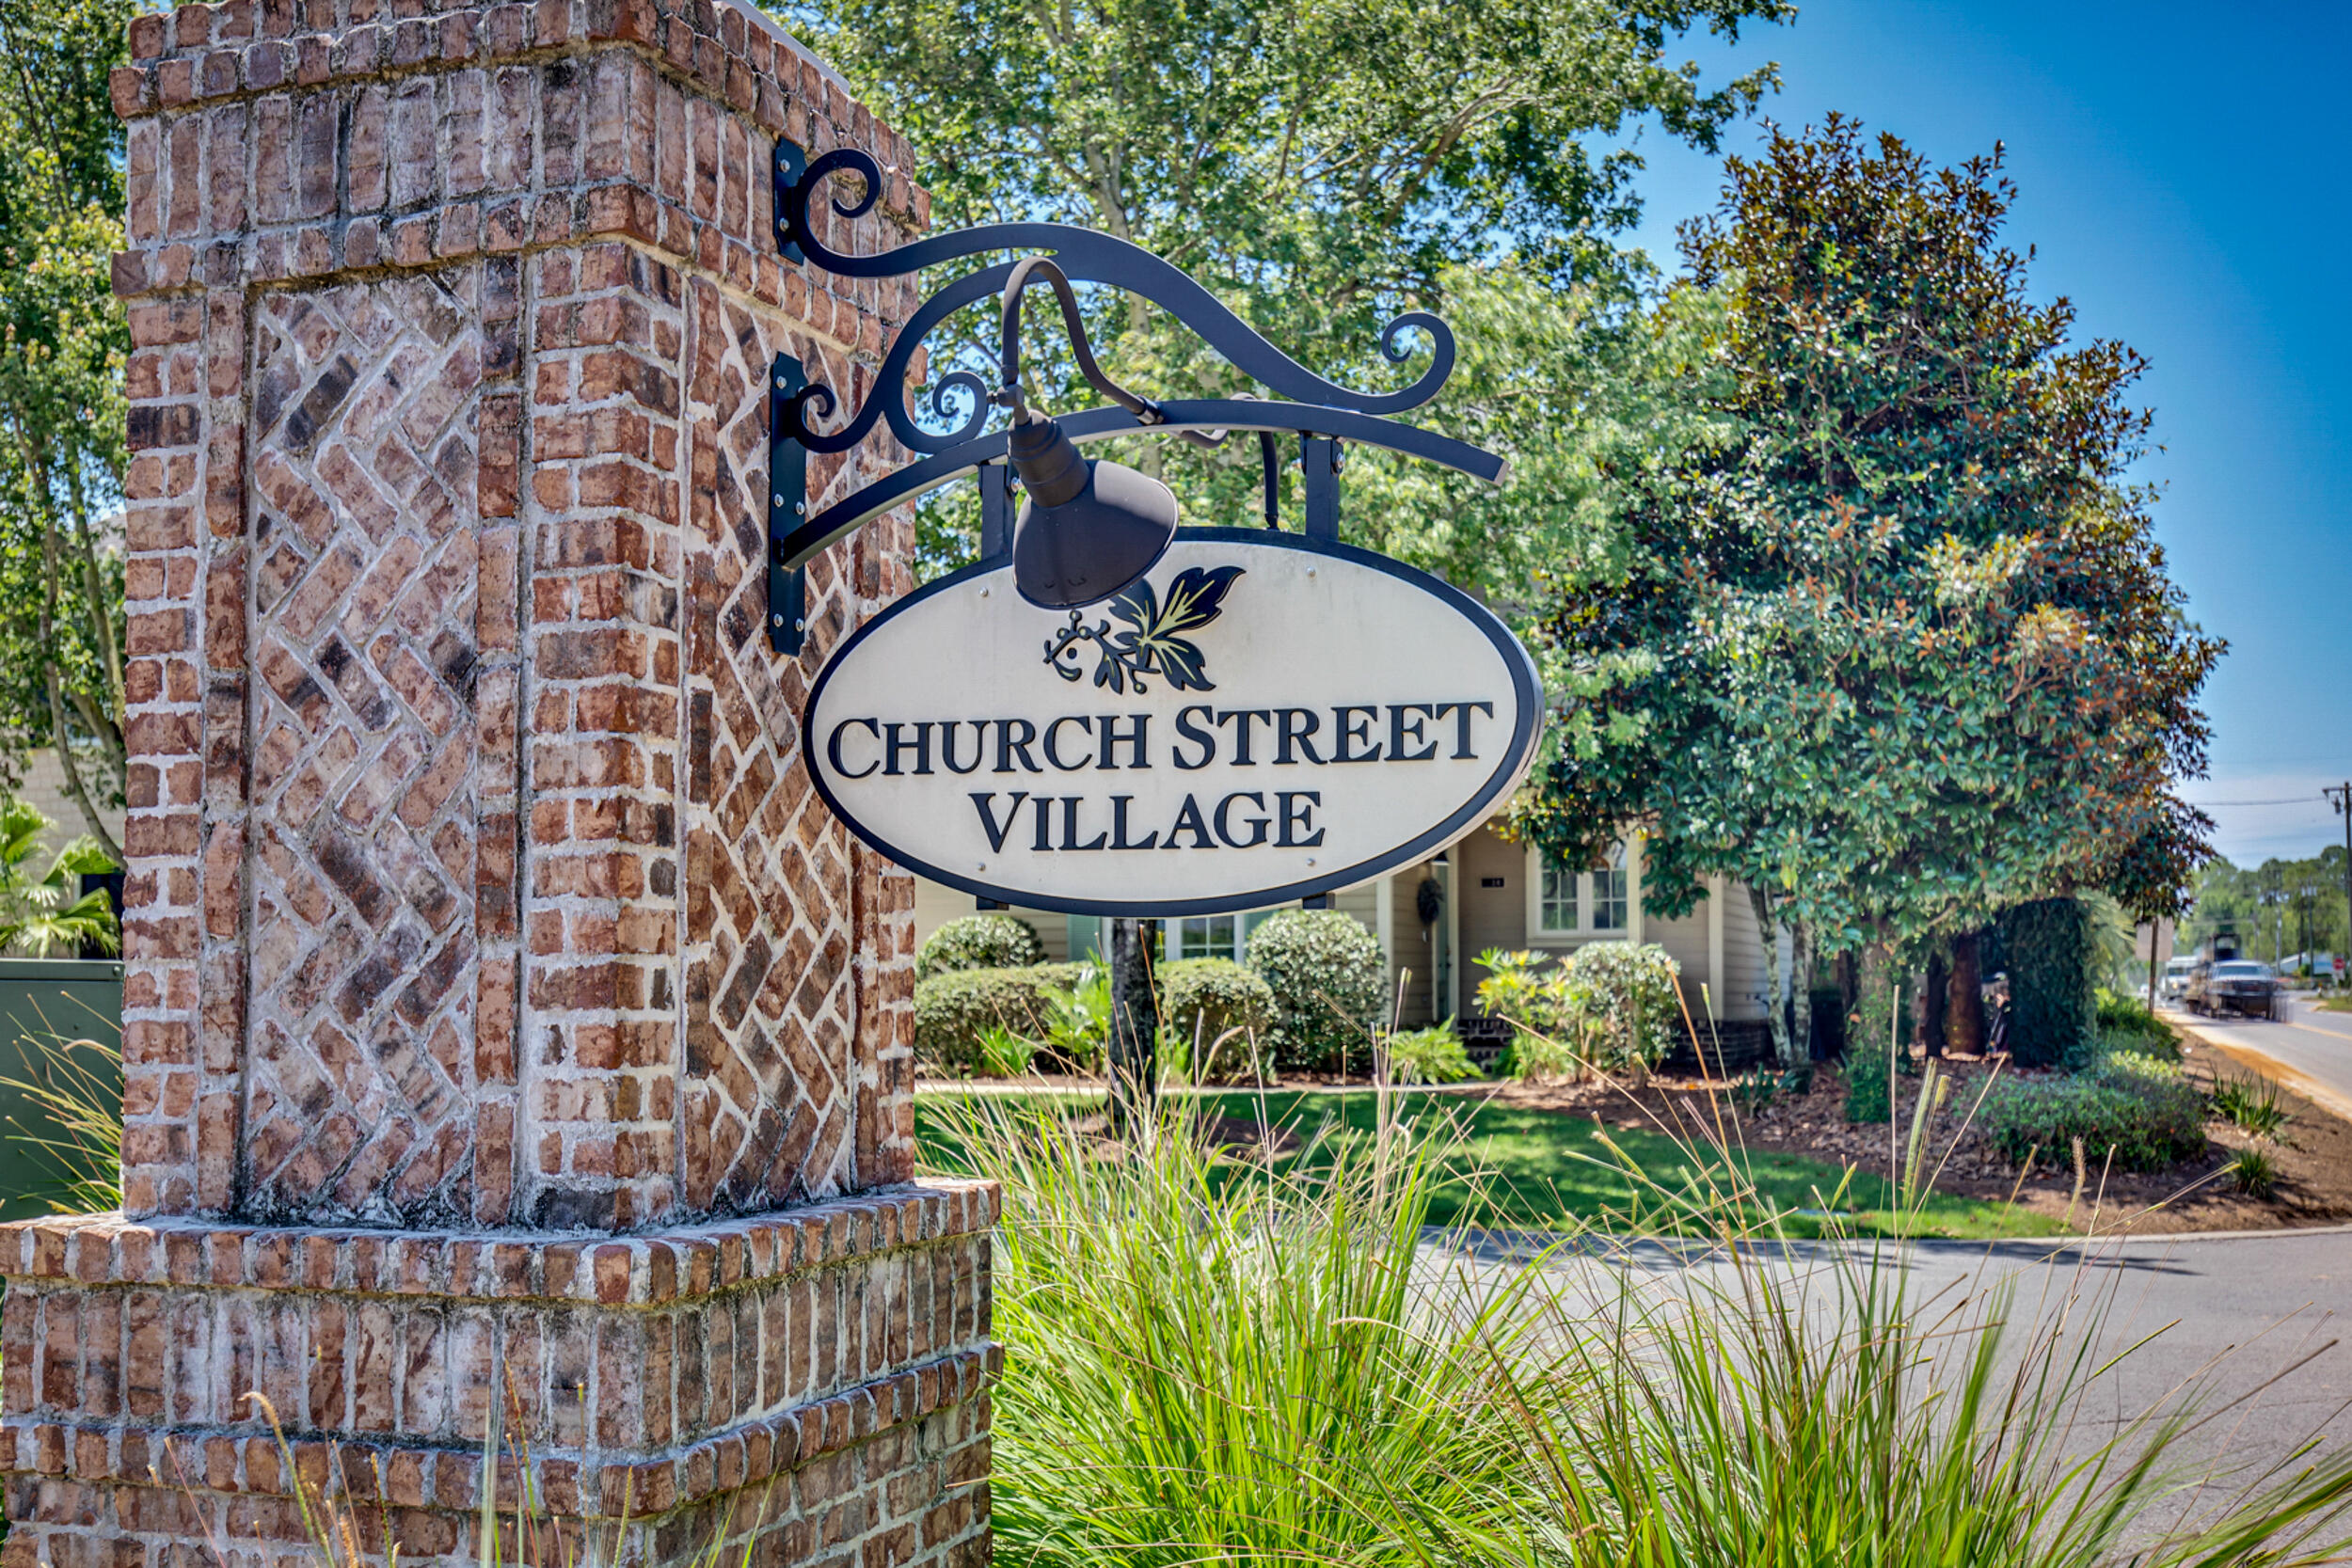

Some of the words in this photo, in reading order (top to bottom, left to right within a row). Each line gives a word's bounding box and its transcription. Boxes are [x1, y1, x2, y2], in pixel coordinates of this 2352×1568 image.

[827, 715, 1153, 780] CHURCH
[1172, 702, 1493, 769] STREET
[968, 792, 1325, 853] VILLAGE
